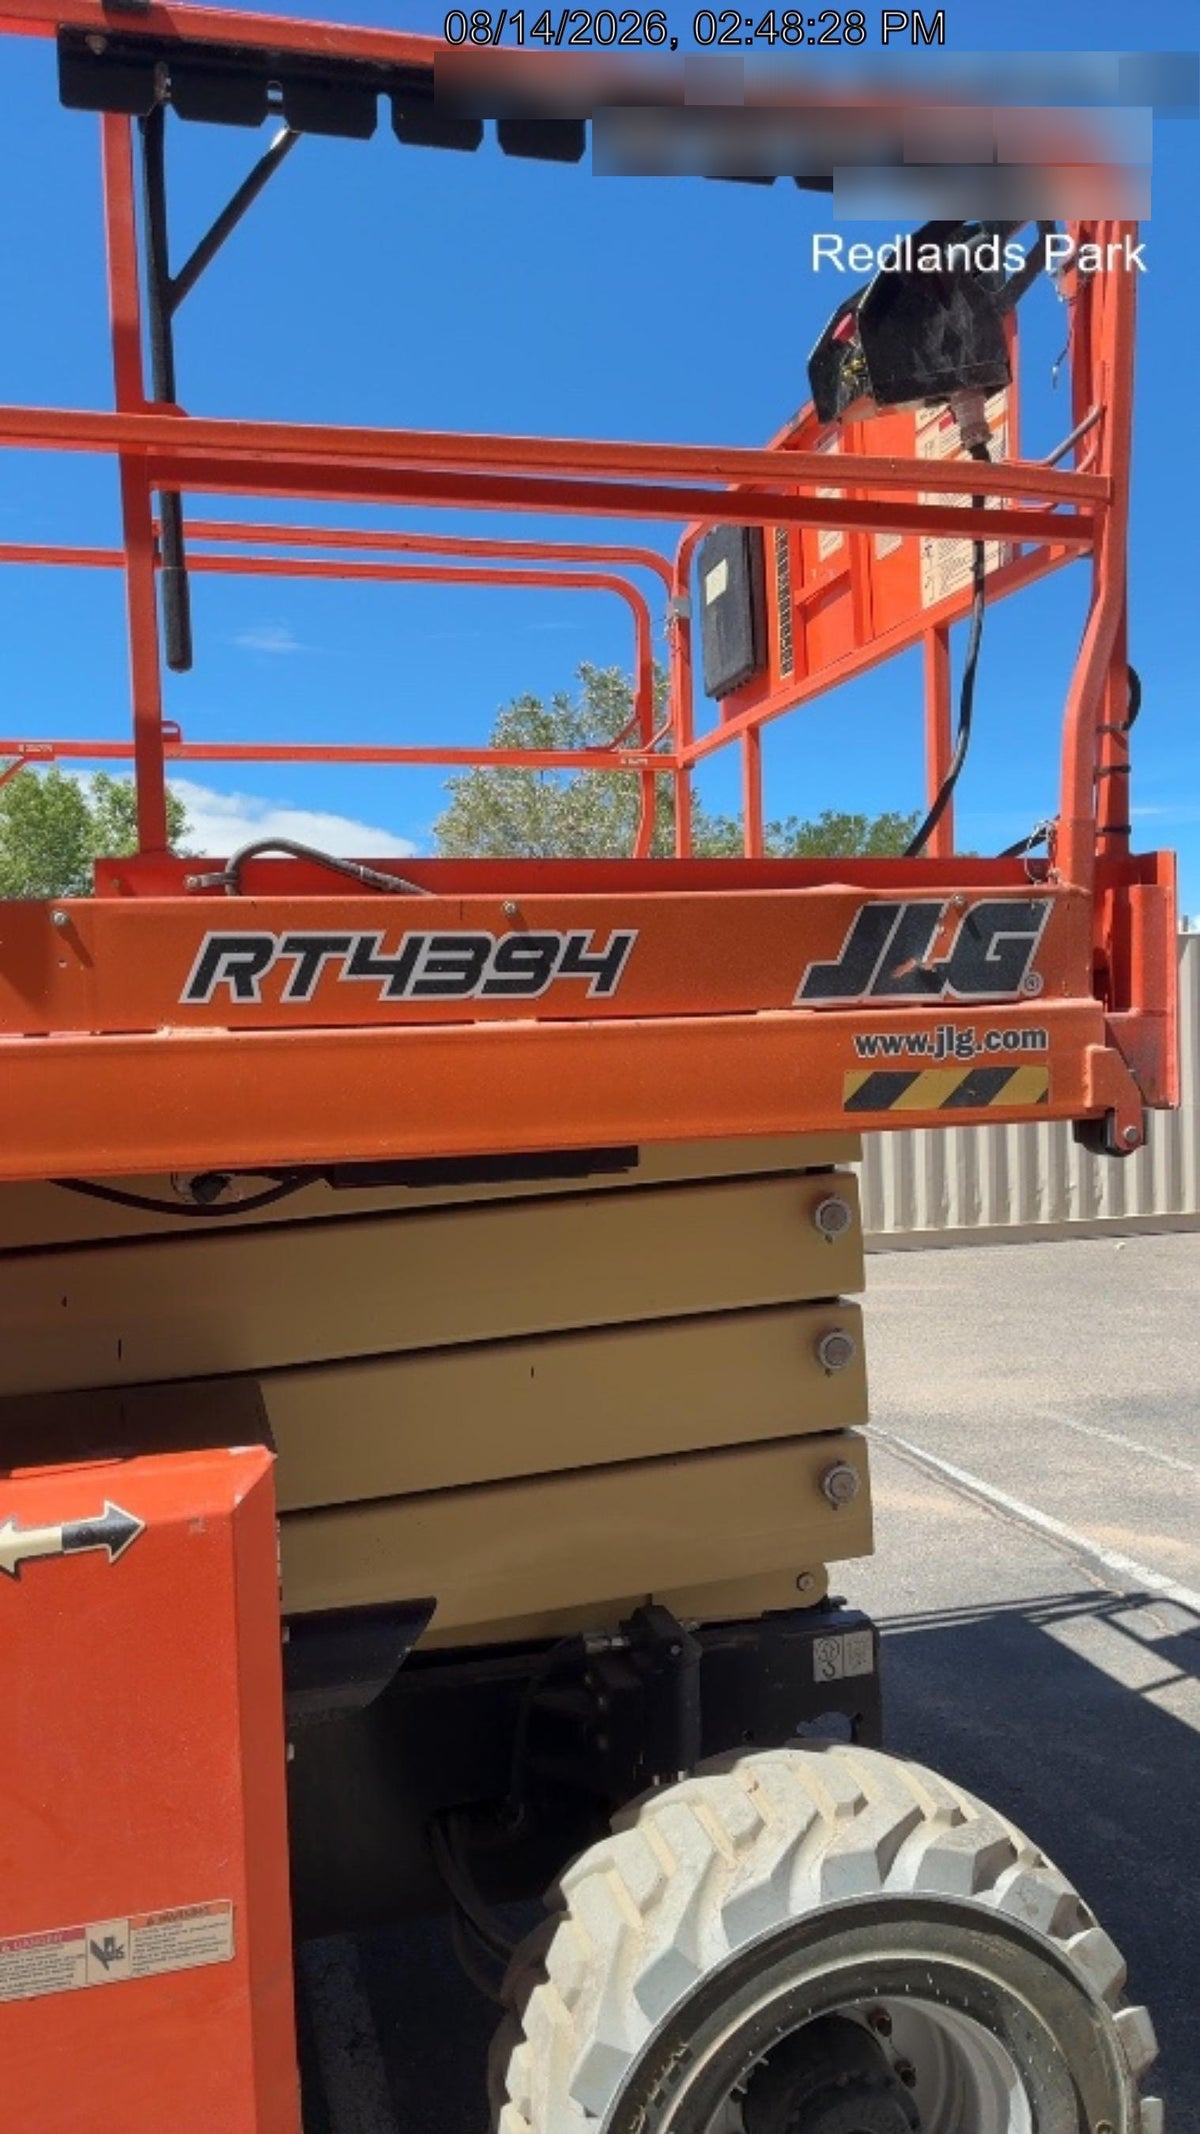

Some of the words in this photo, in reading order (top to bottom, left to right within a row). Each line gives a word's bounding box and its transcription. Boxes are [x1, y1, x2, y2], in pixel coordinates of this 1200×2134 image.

[179, 928, 639, 1004] RT4394
[793, 898, 1055, 1005] JLG
[854, 1025, 1050, 1061] www.jlg.com
